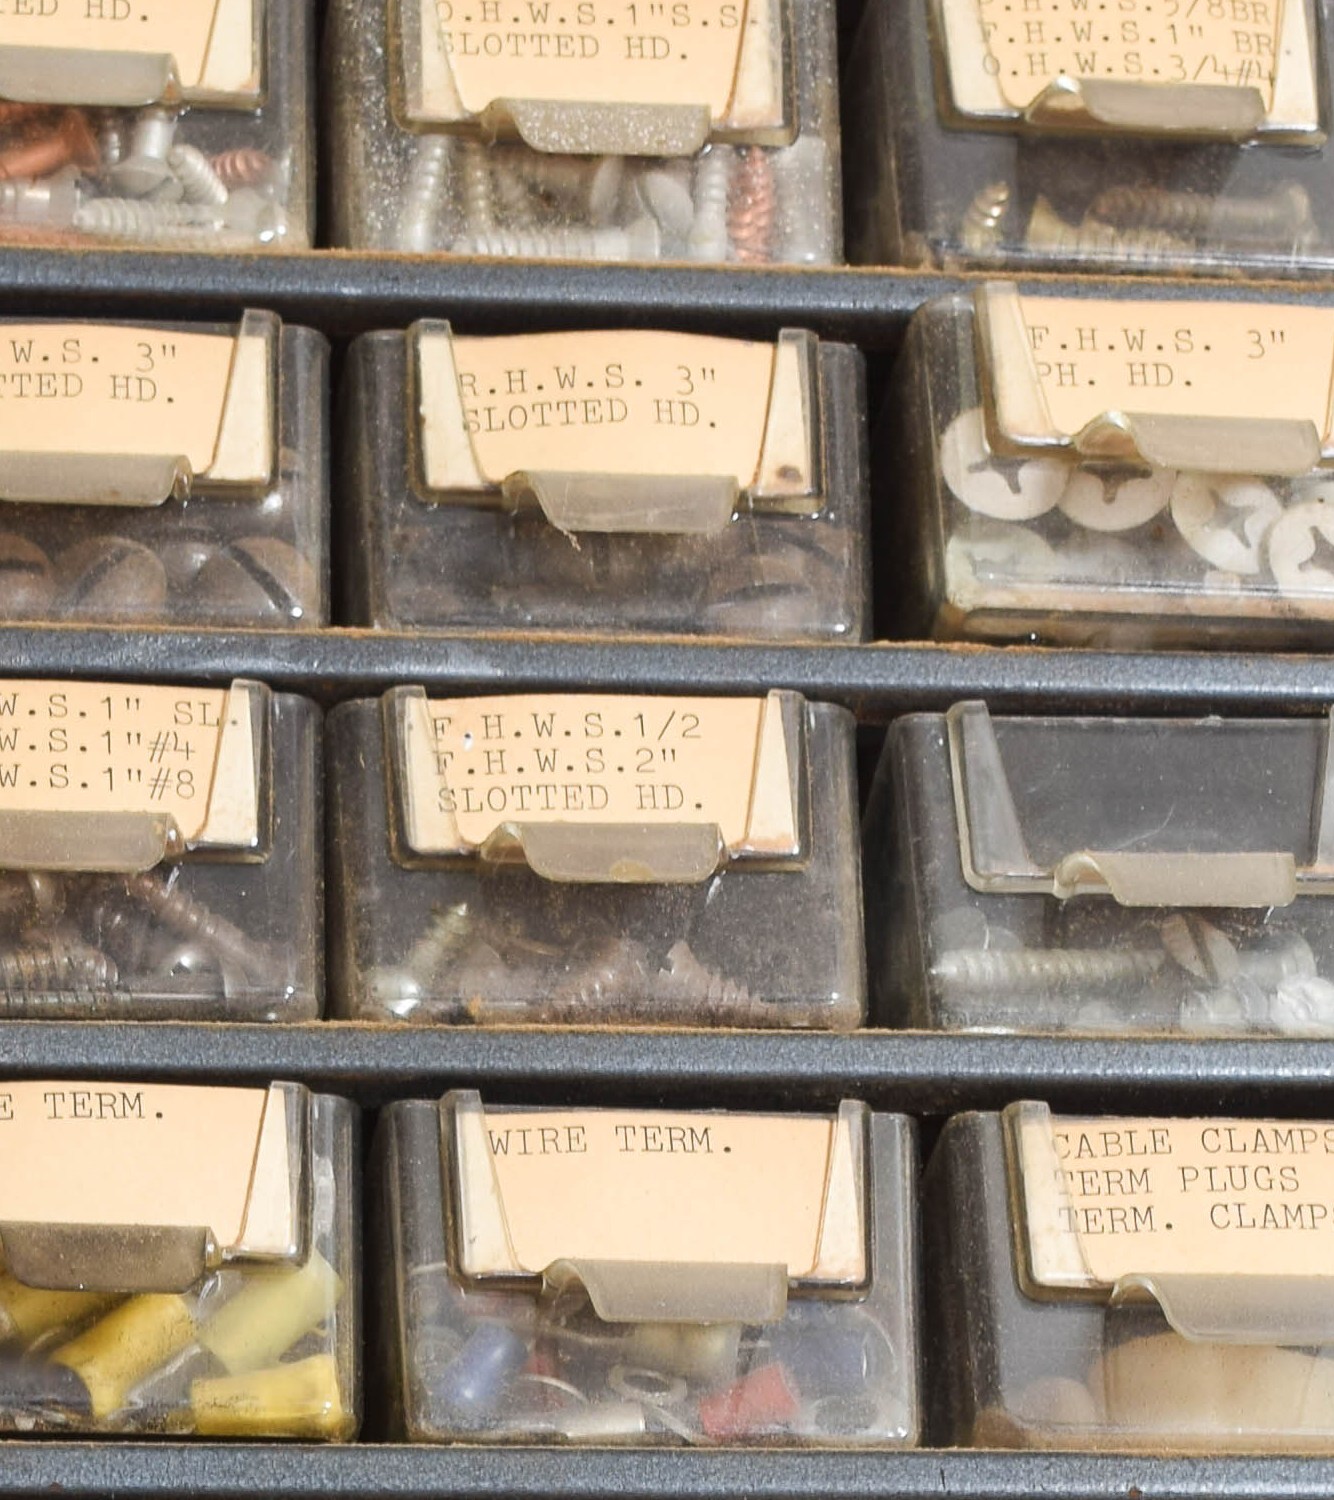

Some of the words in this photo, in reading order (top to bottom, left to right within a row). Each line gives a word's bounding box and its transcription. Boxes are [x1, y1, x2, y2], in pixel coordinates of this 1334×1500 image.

[626, 35, 688, 61] HD.
[136, 342, 177, 375] 3"
[1030, 325, 1212, 354] F.H.W.S.
[1246, 329, 1287, 360] 3"
[109, 374, 174, 404] HD.
[458, 364, 643, 398] R.H.W.S.
[676, 365, 717, 396] 3"
[1127, 362, 1193, 388] HD.
[463, 398, 628, 436] SLOTTED
[654, 399, 717, 429] HD.
[437, 782, 610, 815] SLOTTED
[636, 782, 703, 811] HD.
[44, 1091, 164, 1121] TERM.
[487, 1125, 588, 1157] WIRE
[615, 1125, 732, 1155] TERM.
[1177, 1165, 1301, 1194] PLUGS
